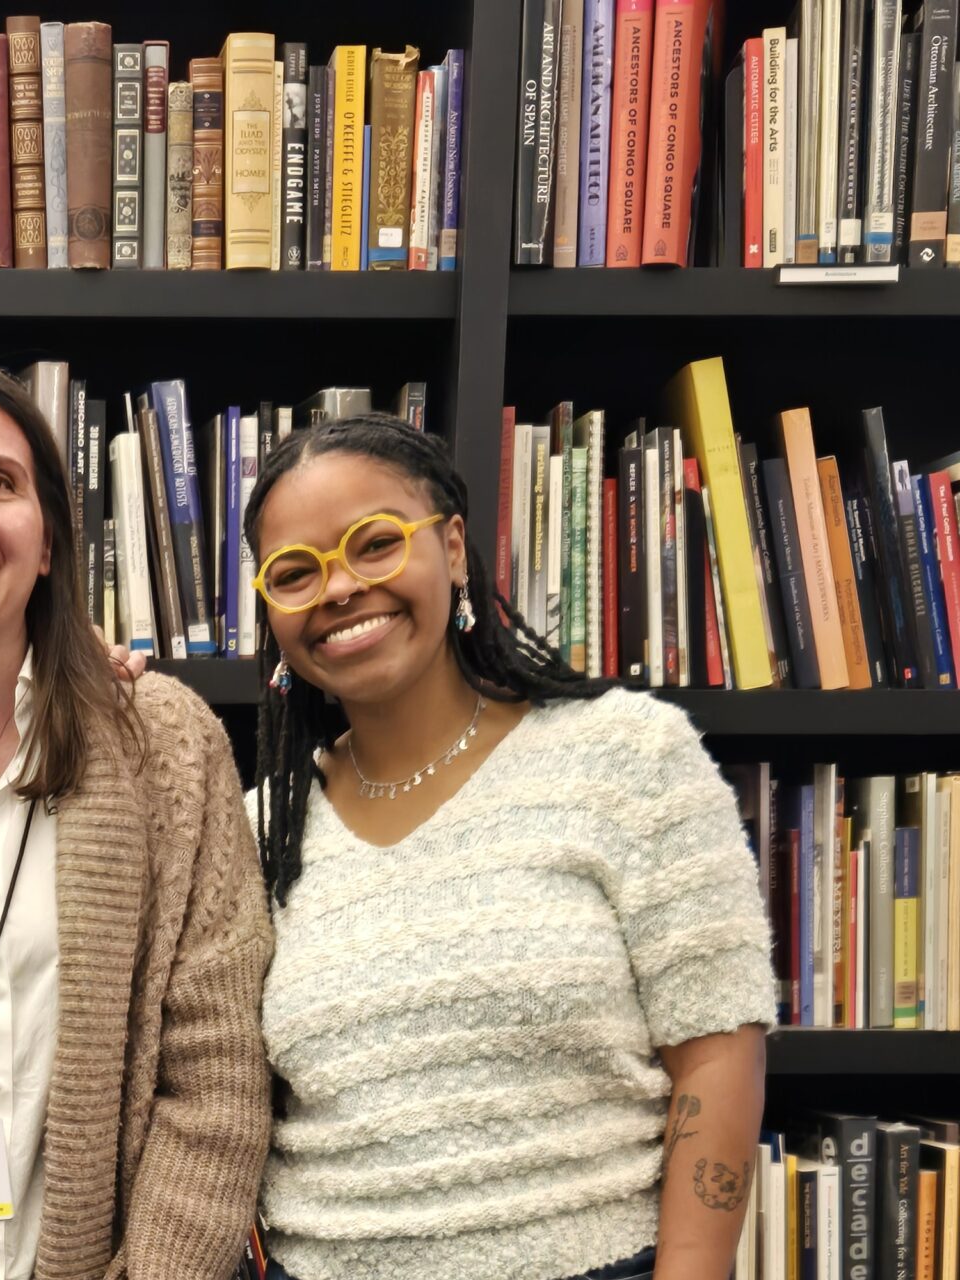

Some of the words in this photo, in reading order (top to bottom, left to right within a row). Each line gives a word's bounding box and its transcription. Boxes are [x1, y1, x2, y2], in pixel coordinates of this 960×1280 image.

[542, 22, 554, 52] ART
[669, 19, 683, 99] ANCESTORS
[927, 34, 941, 84] Ottoman
[541, 54, 553, 87] AND
[627, 25, 640, 104] ANCESTORS
[767, 38, 780, 85] Building
[525, 79, 537, 100] OF
[668, 103, 678, 121] OF
[767, 86, 779, 104] for
[240, 130, 263, 139] ILIAD
[342, 111, 355, 164] O'KEEFFE
[523, 103, 536, 146] SPAIN
[626, 108, 637, 126] OF
[767, 106, 779, 125] the
[923, 84, 938, 150] Architecture
[234, 147, 268, 156] ODYSSEY
[537, 90, 551, 203] ARCHITECTURE
[624, 129, 636, 177] CONGO
[665, 124, 677, 172] CONGO
[766, 127, 778, 152] Arts
[235, 169, 266, 178] HOMER
[286, 143, 304, 224] ENDGAME
[312, 177, 320, 206] SMITH
[342, 167, 354, 176] &
[340, 181, 353, 236] STIEGLITZ
[622, 181, 633, 234] SQUARE
[661, 176, 674, 230] SQUARE
[77, 391, 86, 447] CHICANO
[76, 450, 84, 474] ART
[88, 439, 99, 489] AMERICANS
[535, 444, 545, 493] Striking
[175, 476, 188, 507] ARTISTS
[534, 495, 544, 571] Resemblance
[904, 519, 917, 559] THOMAS
[910, 562, 925, 616] GILCREASE
[878, 791, 890, 839] Stephens
[878, 841, 889, 894] Collection
[895, 1199, 908, 1244] Collecting
[894, 1246, 907, 1262] for
